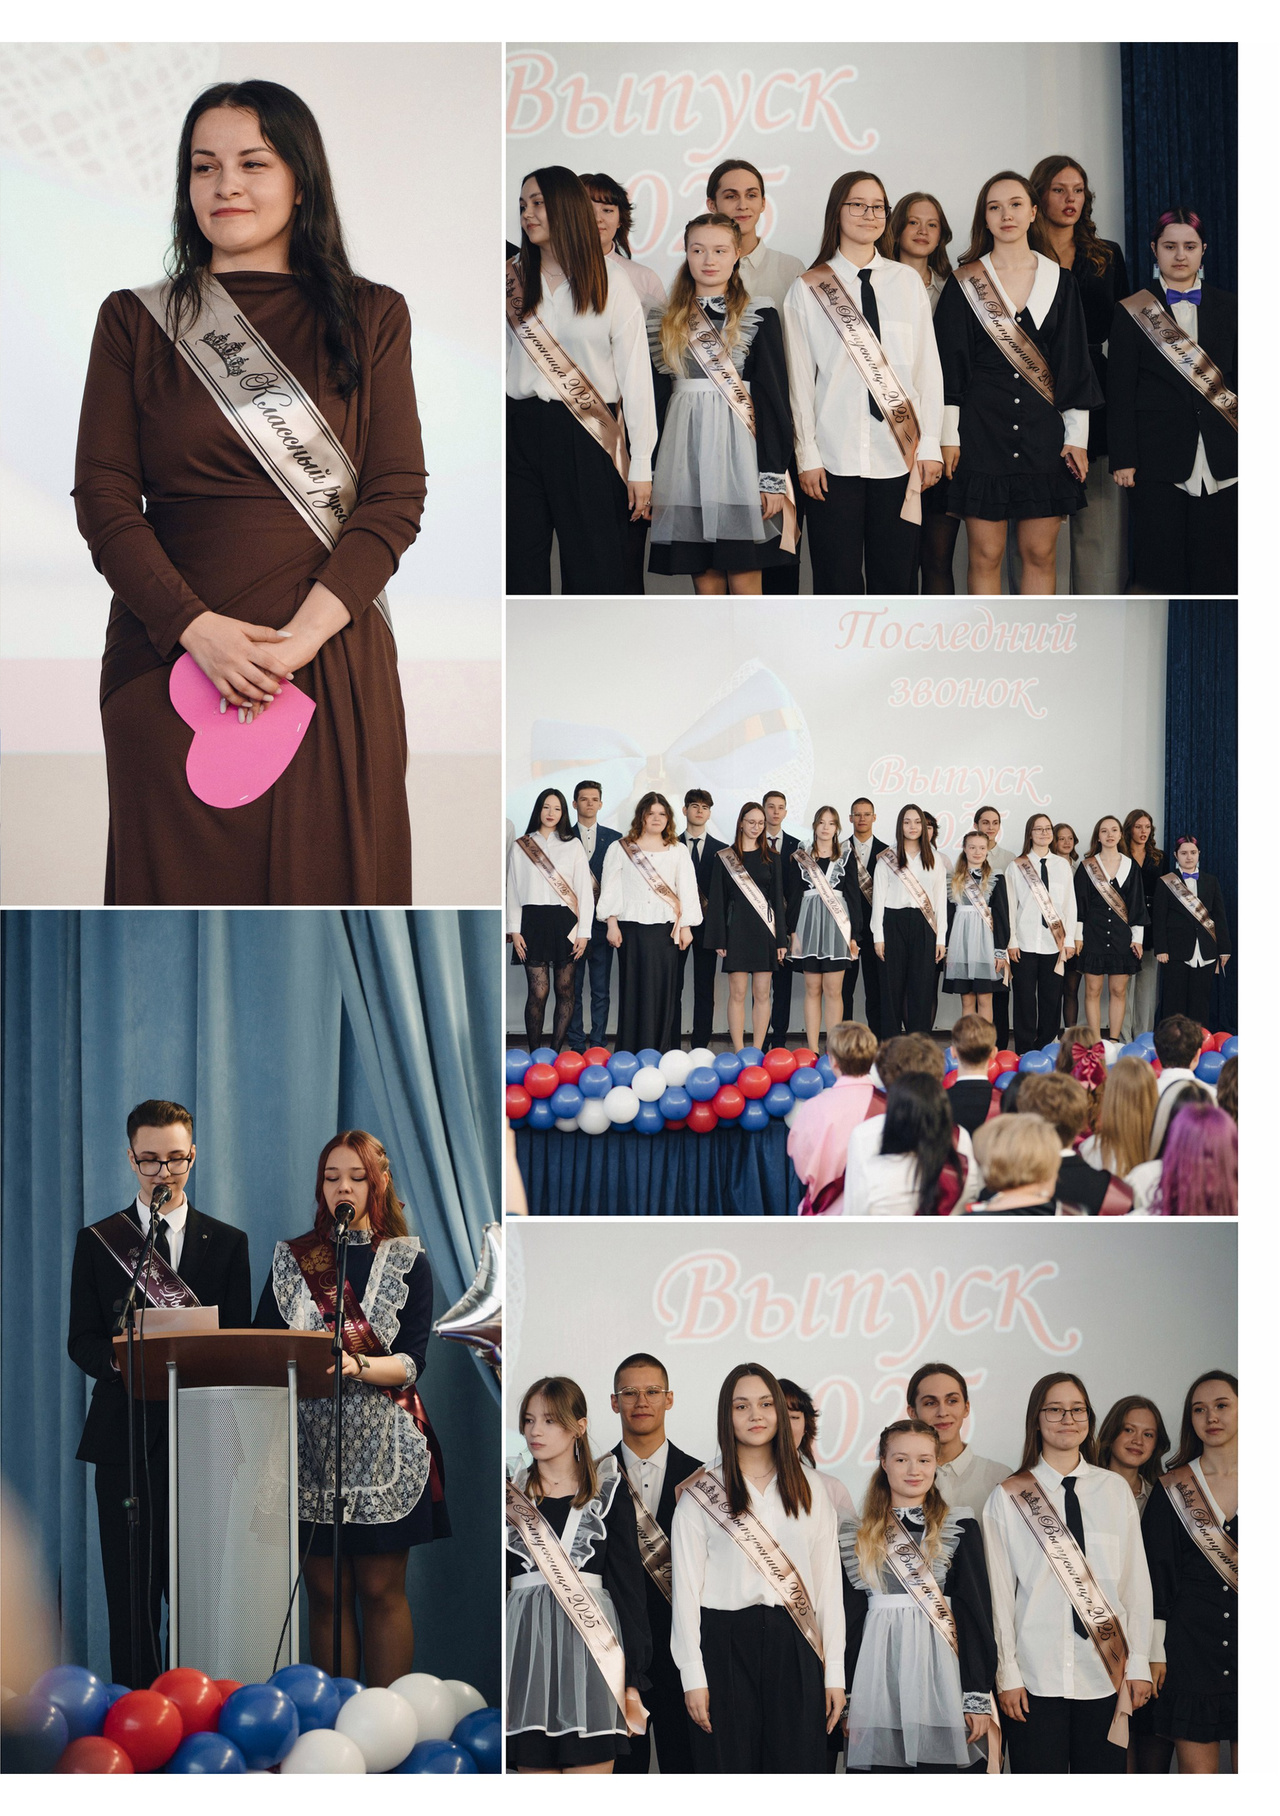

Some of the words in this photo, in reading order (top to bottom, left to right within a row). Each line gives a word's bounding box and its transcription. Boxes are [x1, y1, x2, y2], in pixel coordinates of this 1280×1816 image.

[506, 49, 880, 164] Выпуск
[696, 331, 753, 410] Выпускница
[835, 304, 889, 392] Выпускница
[881, 390, 911, 424] 2025
[983, 300, 1040, 373] Выпускница
[1159, 328, 1218, 395] Выпускница
[239, 372, 333, 485] Классный
[562, 378, 597, 411] 2025
[833, 604, 1078, 653] Последний
[888, 676, 1048, 720] звонок
[868, 754, 1053, 810] Выпуск
[653, 1247, 1083, 1373] Выпуск
[513, 1504, 572, 1593] Выпускница
[567, 1593, 601, 1629] 2025
[783, 1581, 811, 1616] 2025
[894, 1543, 955, 1628] Выпускница
[1037, 1515, 1094, 1606] Выпускница
[1086, 1606, 1118, 1641] 2025
